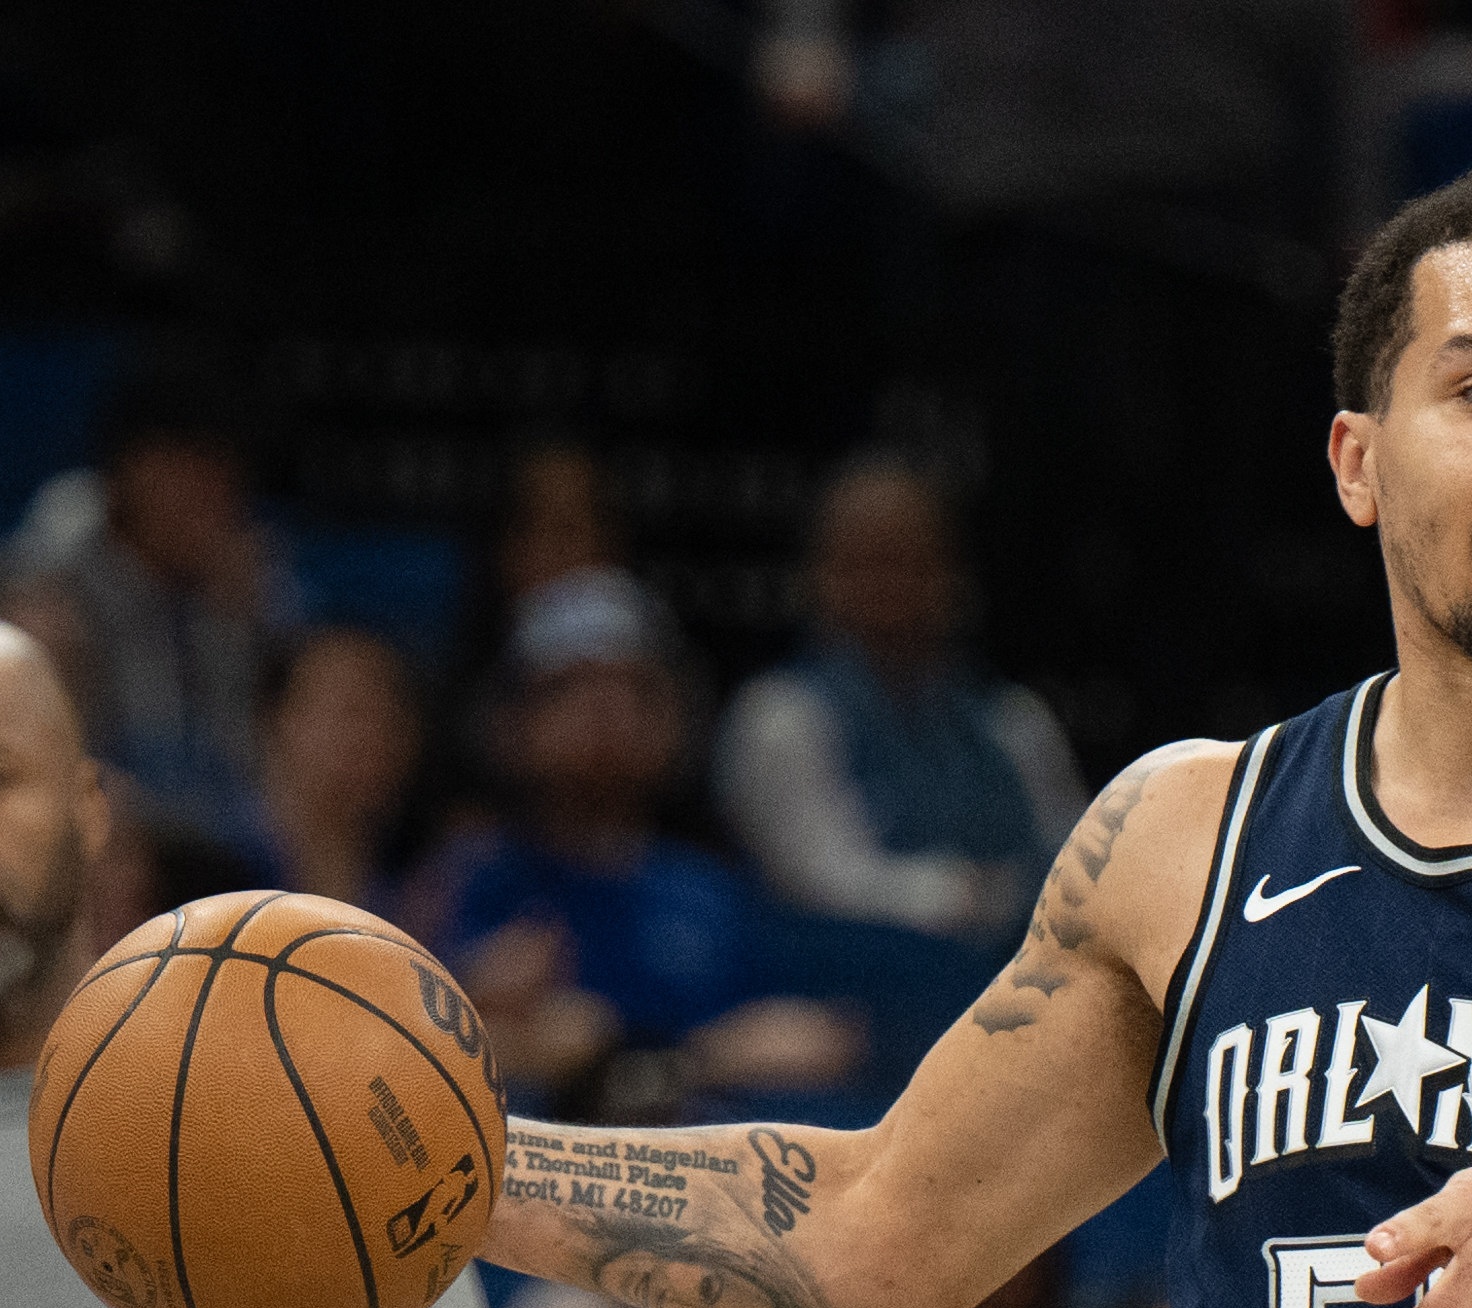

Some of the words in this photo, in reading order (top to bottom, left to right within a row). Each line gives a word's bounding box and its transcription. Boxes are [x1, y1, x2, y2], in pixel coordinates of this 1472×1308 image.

[369, 1075, 404, 1123] OFFICIAL
[396, 1115, 421, 1152] GAME
[525, 1150, 622, 1181] Thornhill
[627, 1164, 688, 1191] Place
[572, 1142, 618, 1159] and
[624, 1143, 739, 1175] Magellan
[569, 1180, 607, 1209] MI
[613, 1187, 689, 1221] 48207
[748, 1127, 816, 1237] Ella
